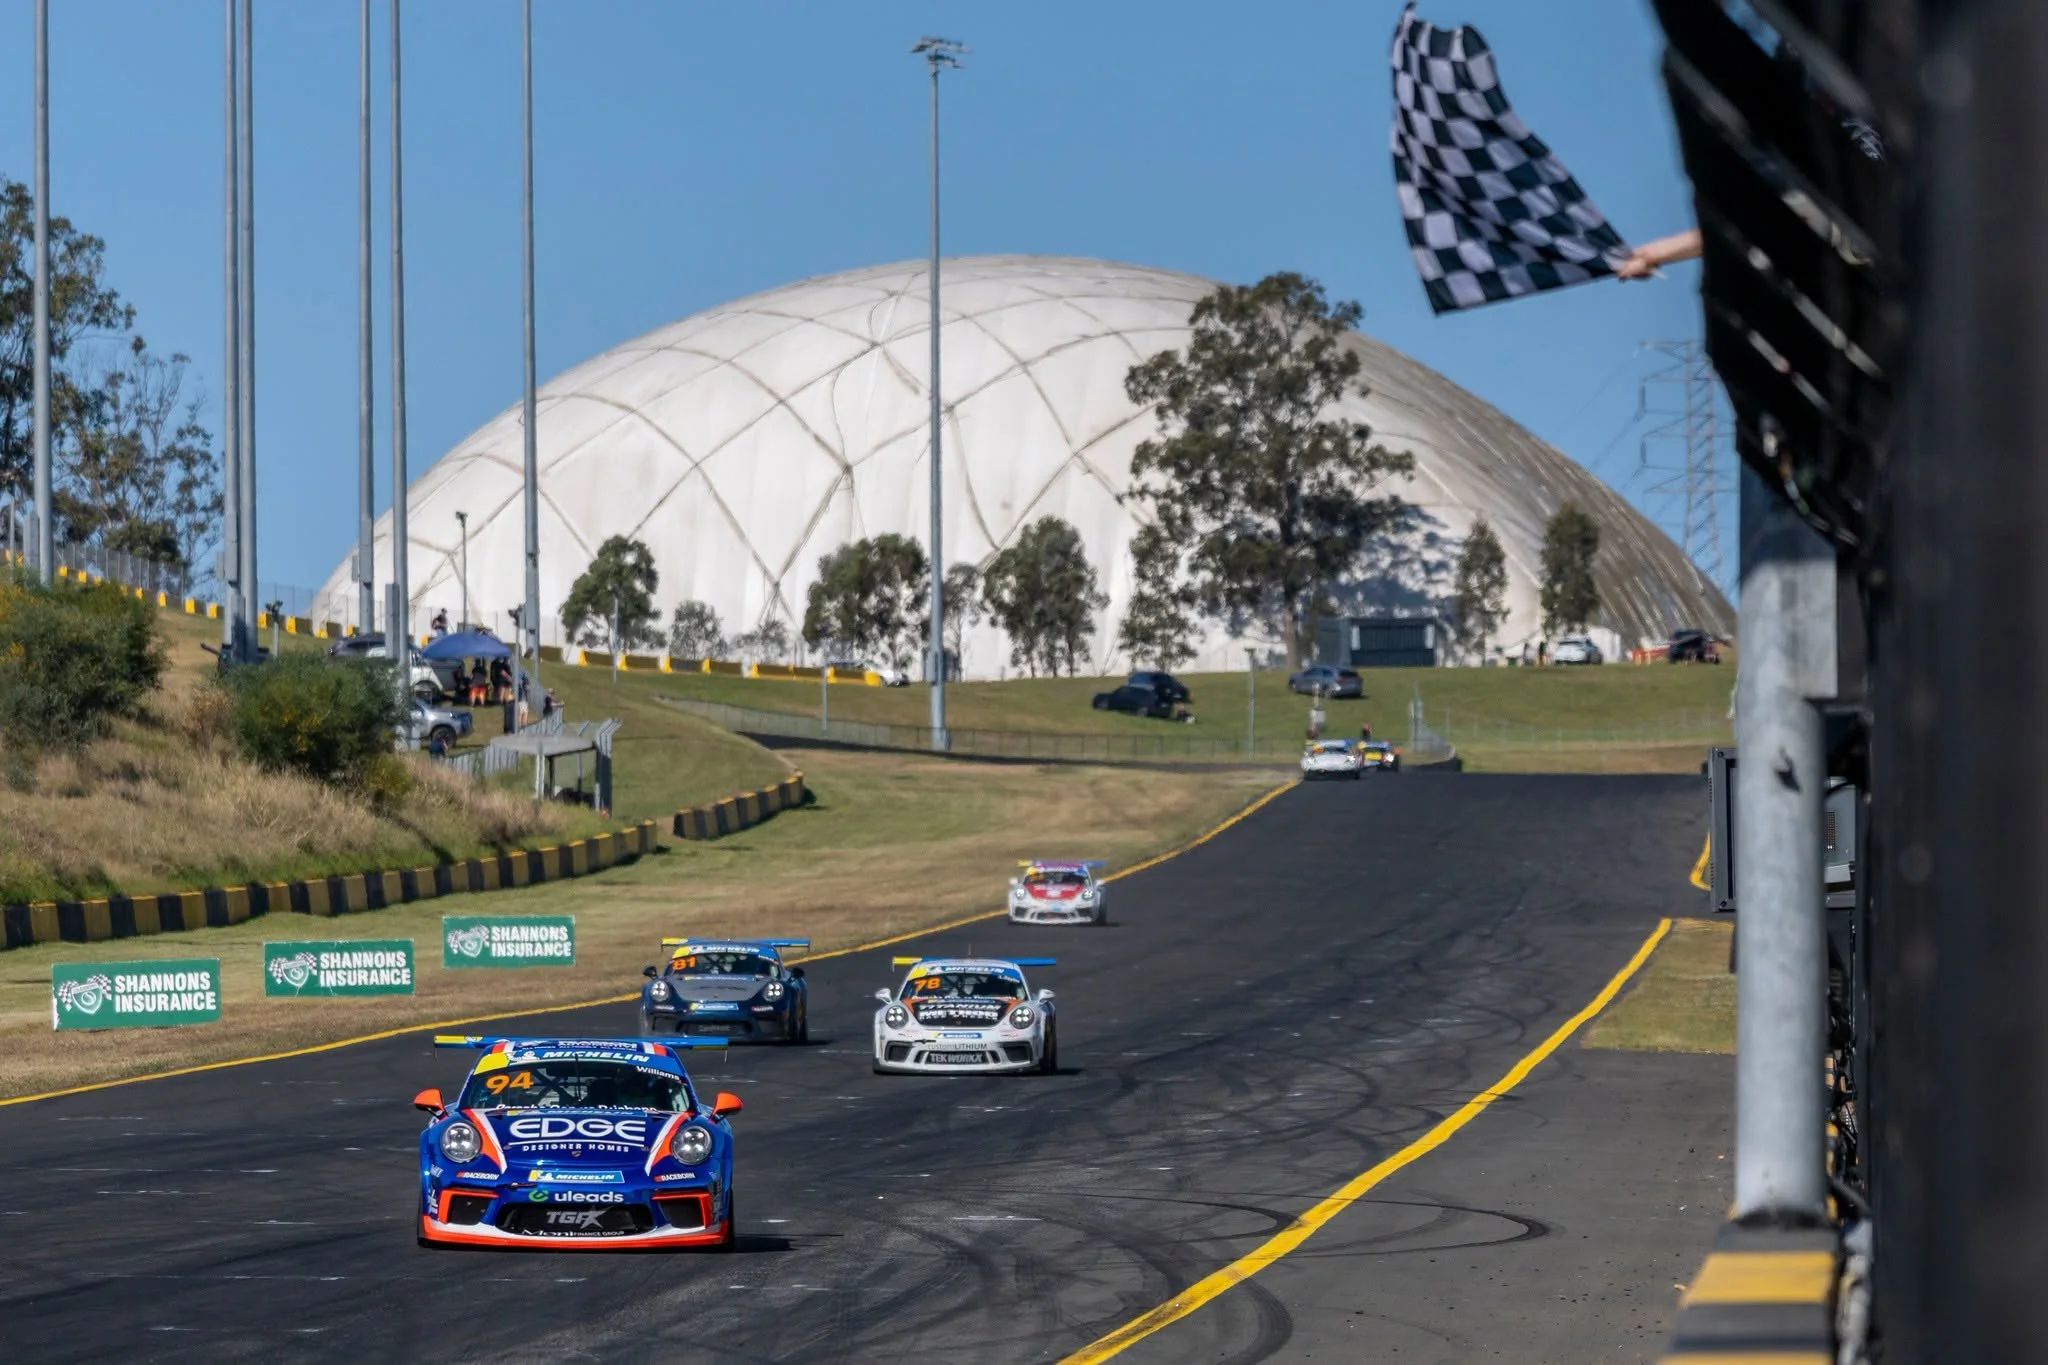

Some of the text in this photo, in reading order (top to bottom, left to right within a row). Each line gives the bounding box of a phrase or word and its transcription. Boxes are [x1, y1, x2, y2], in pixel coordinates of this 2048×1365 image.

[491, 926, 568, 942] SHANNONS
[491, 942, 572, 957] INSURANCE
[320, 950, 407, 969] SHANNONS
[115, 972, 210, 993] SHANNONS
[319, 968, 411, 987] INSURANCE
[914, 977, 941, 992] 78
[115, 992, 217, 1013] INSURANCE
[543, 1051, 650, 1063] MICHELIN
[636, 1065, 680, 1081] Williams
[486, 1071, 534, 1095] 94
[510, 1117, 646, 1142] EDGE
[522, 1143, 630, 1152] DESIGNER HOMES
[463, 1171, 500, 1180] RACEBORN
[661, 1172, 696, 1181] RACEBORN
[554, 1190, 624, 1202] uleads
